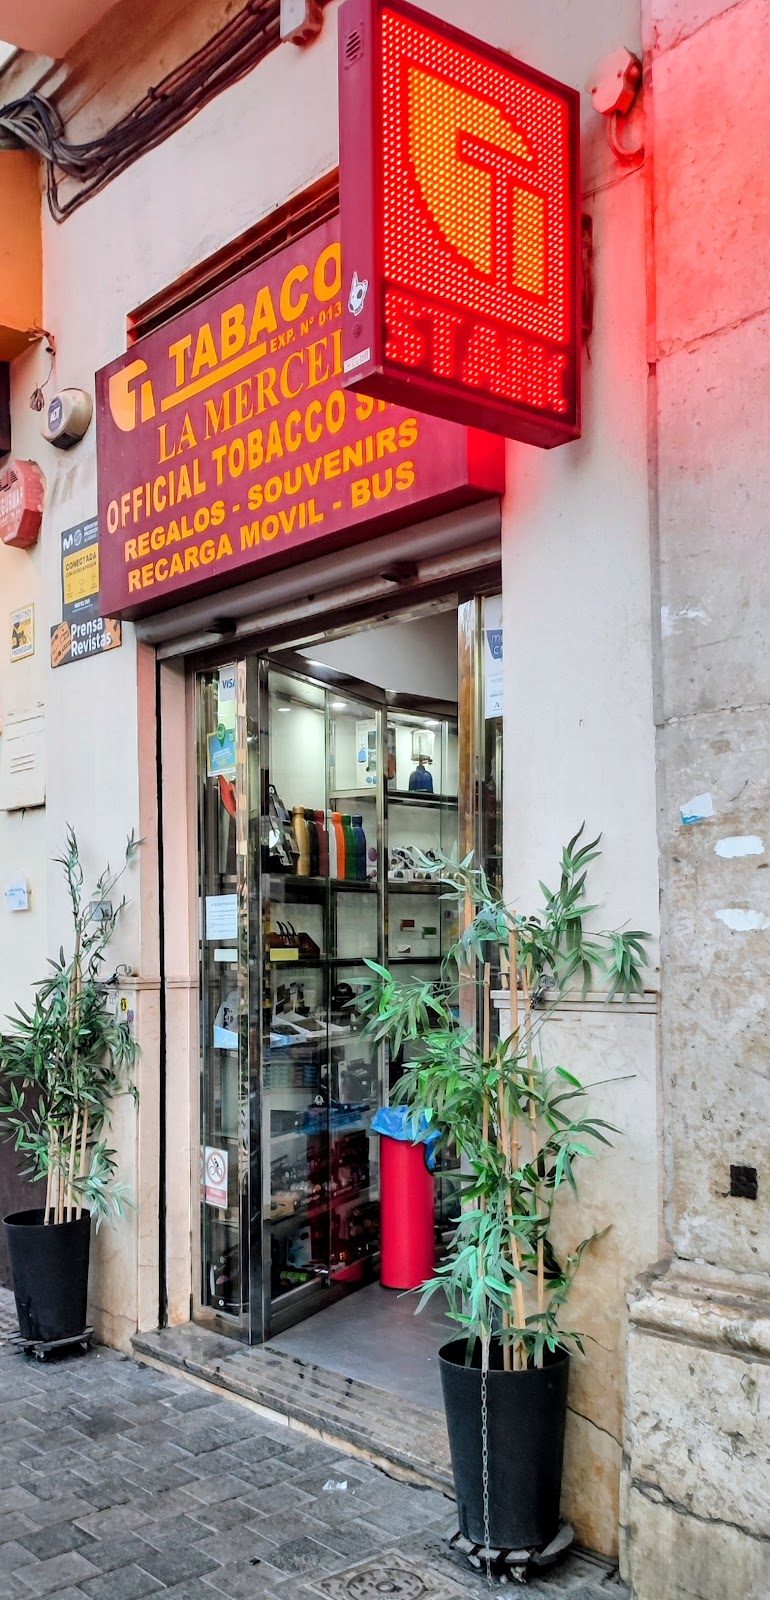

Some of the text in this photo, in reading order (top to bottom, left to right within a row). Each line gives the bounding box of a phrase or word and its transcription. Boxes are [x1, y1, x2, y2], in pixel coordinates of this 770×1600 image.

[270, 327, 296, 353] EXP.
[106, 457, 206, 535] OFFICIAL
[212, 389, 347, 486] TOBACCO
[157, 418, 197, 465] LA
[124, 499, 226, 562] REGALOS
[247, 417, 419, 511] SOUVENIRS
[127, 536, 233, 593] RECARGA
[240, 505, 324, 549] MOVIL
[351, 460, 416, 509] BUS
[70, 617, 103, 639] Prensa
[71, 631, 112, 658] Revistas
